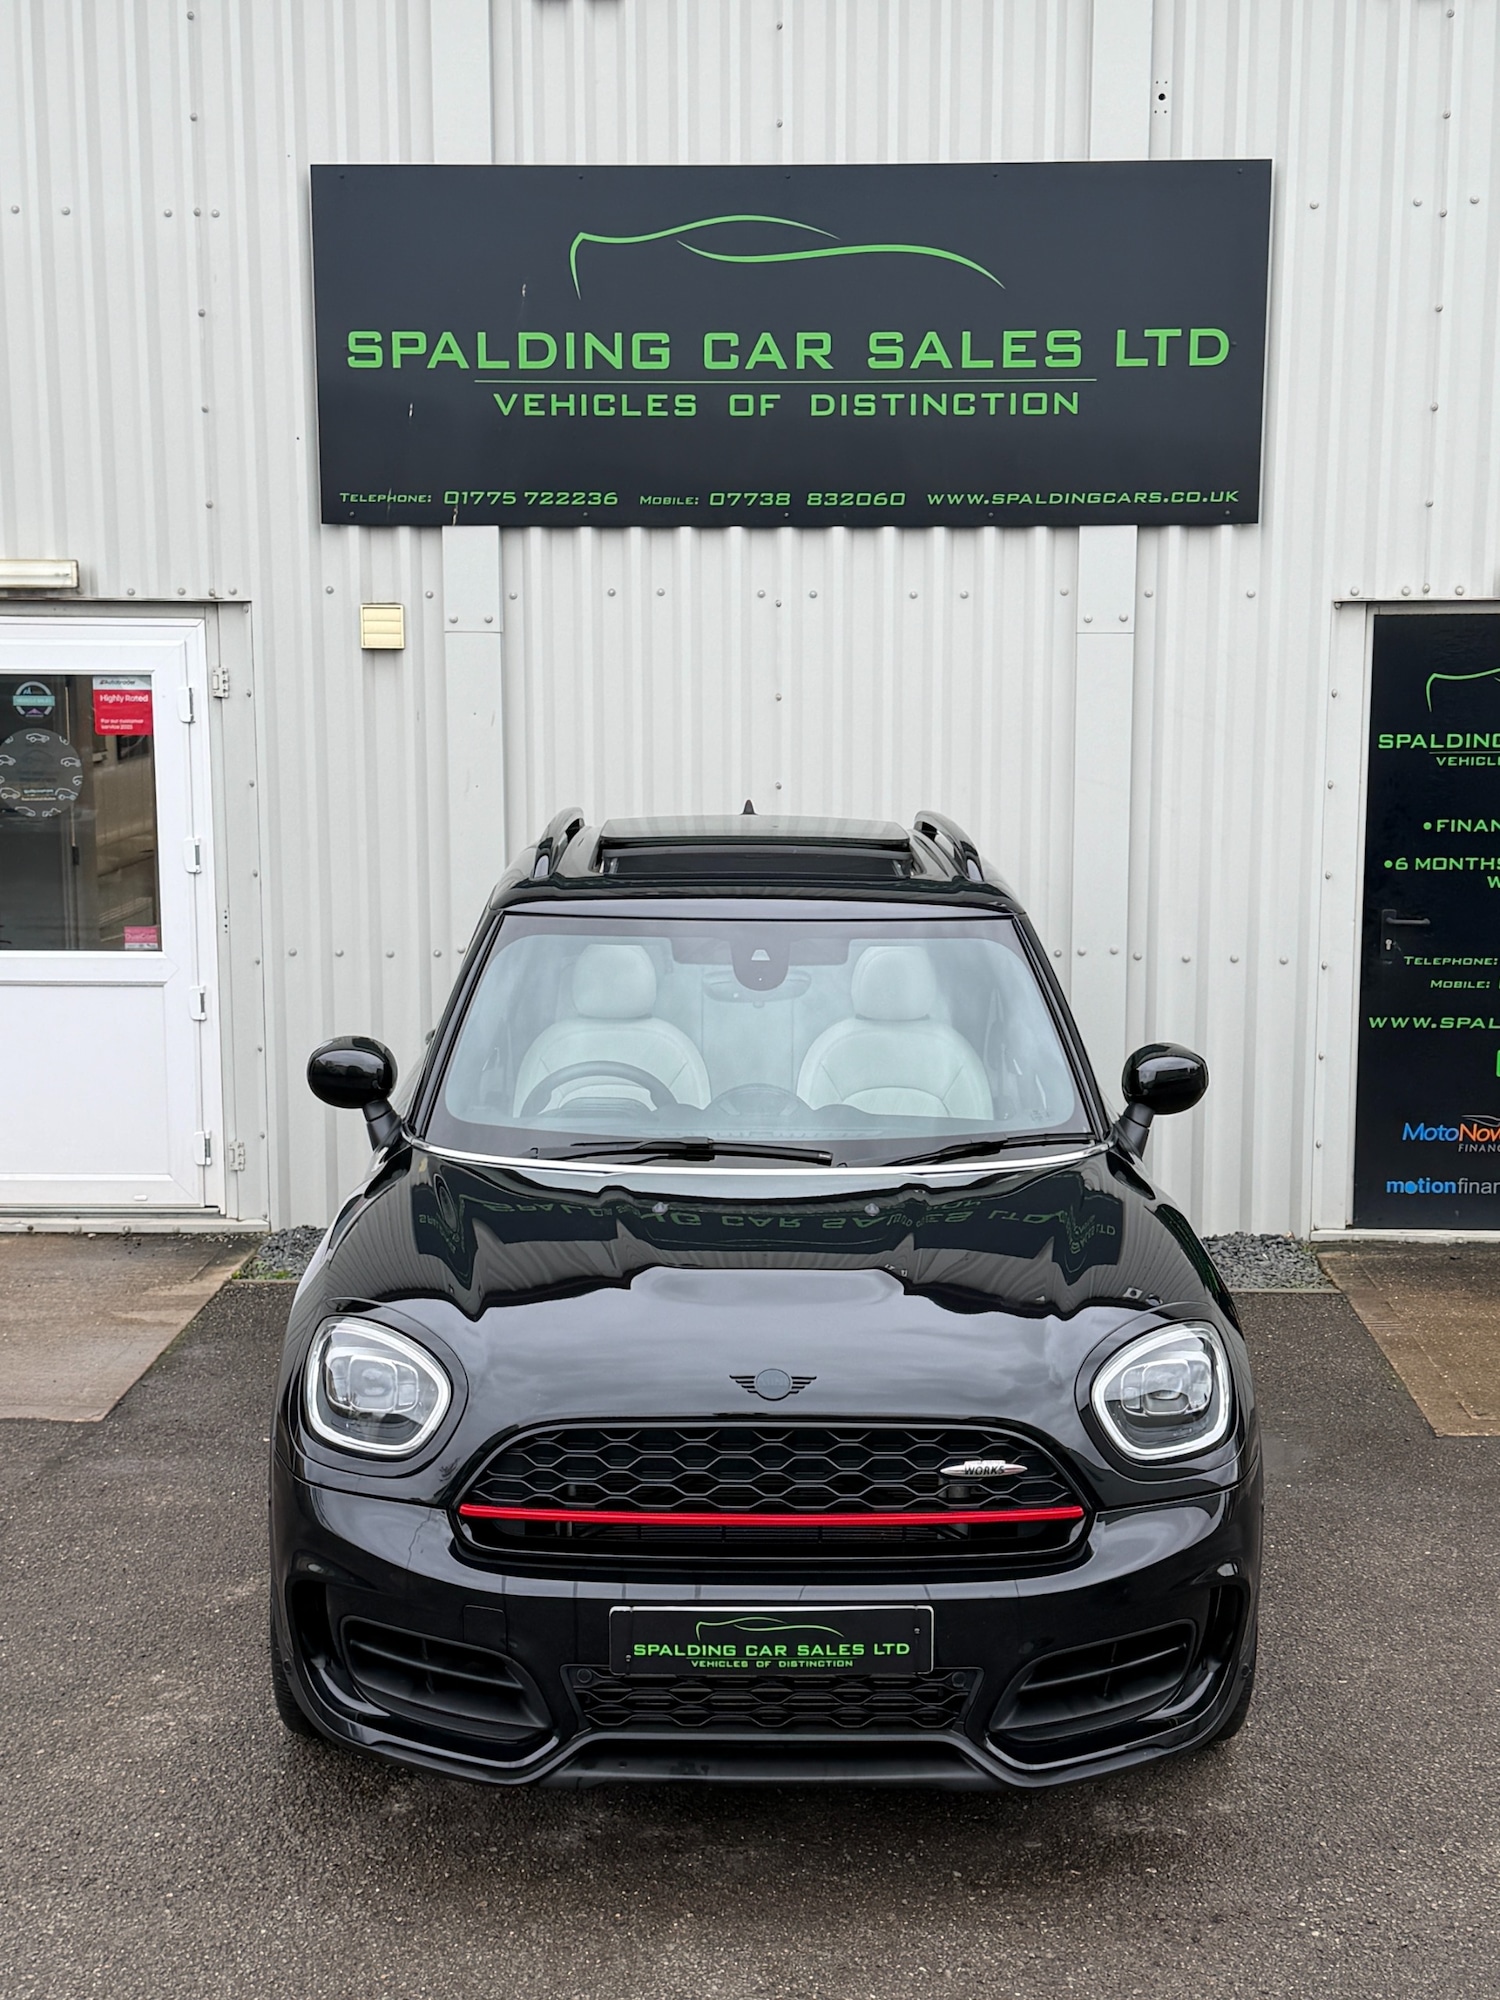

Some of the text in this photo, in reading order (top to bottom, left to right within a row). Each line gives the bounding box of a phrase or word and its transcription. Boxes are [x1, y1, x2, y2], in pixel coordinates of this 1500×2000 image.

[347, 327, 1230, 370] SPALDING CAR SALES LTD
[493, 391, 1079, 418] VEHICLES OF DISTINCTION
[443, 489, 517, 506] 01775
[523, 489, 619, 507] 722236
[708, 491, 792, 507] 07738
[806, 491, 907, 507] 832060
[100, 694, 149, 704] Highly Rated
[1436, 756, 1500, 766] VEHICL
[1395, 857, 1500, 870] 6 MONTH
[964, 1465, 1005, 1476] WORKS
[633, 1642, 910, 1657] SPALDING CAR SALES LTD
[690, 1660, 854, 1668] VEHICLES OF DISTINCTION
